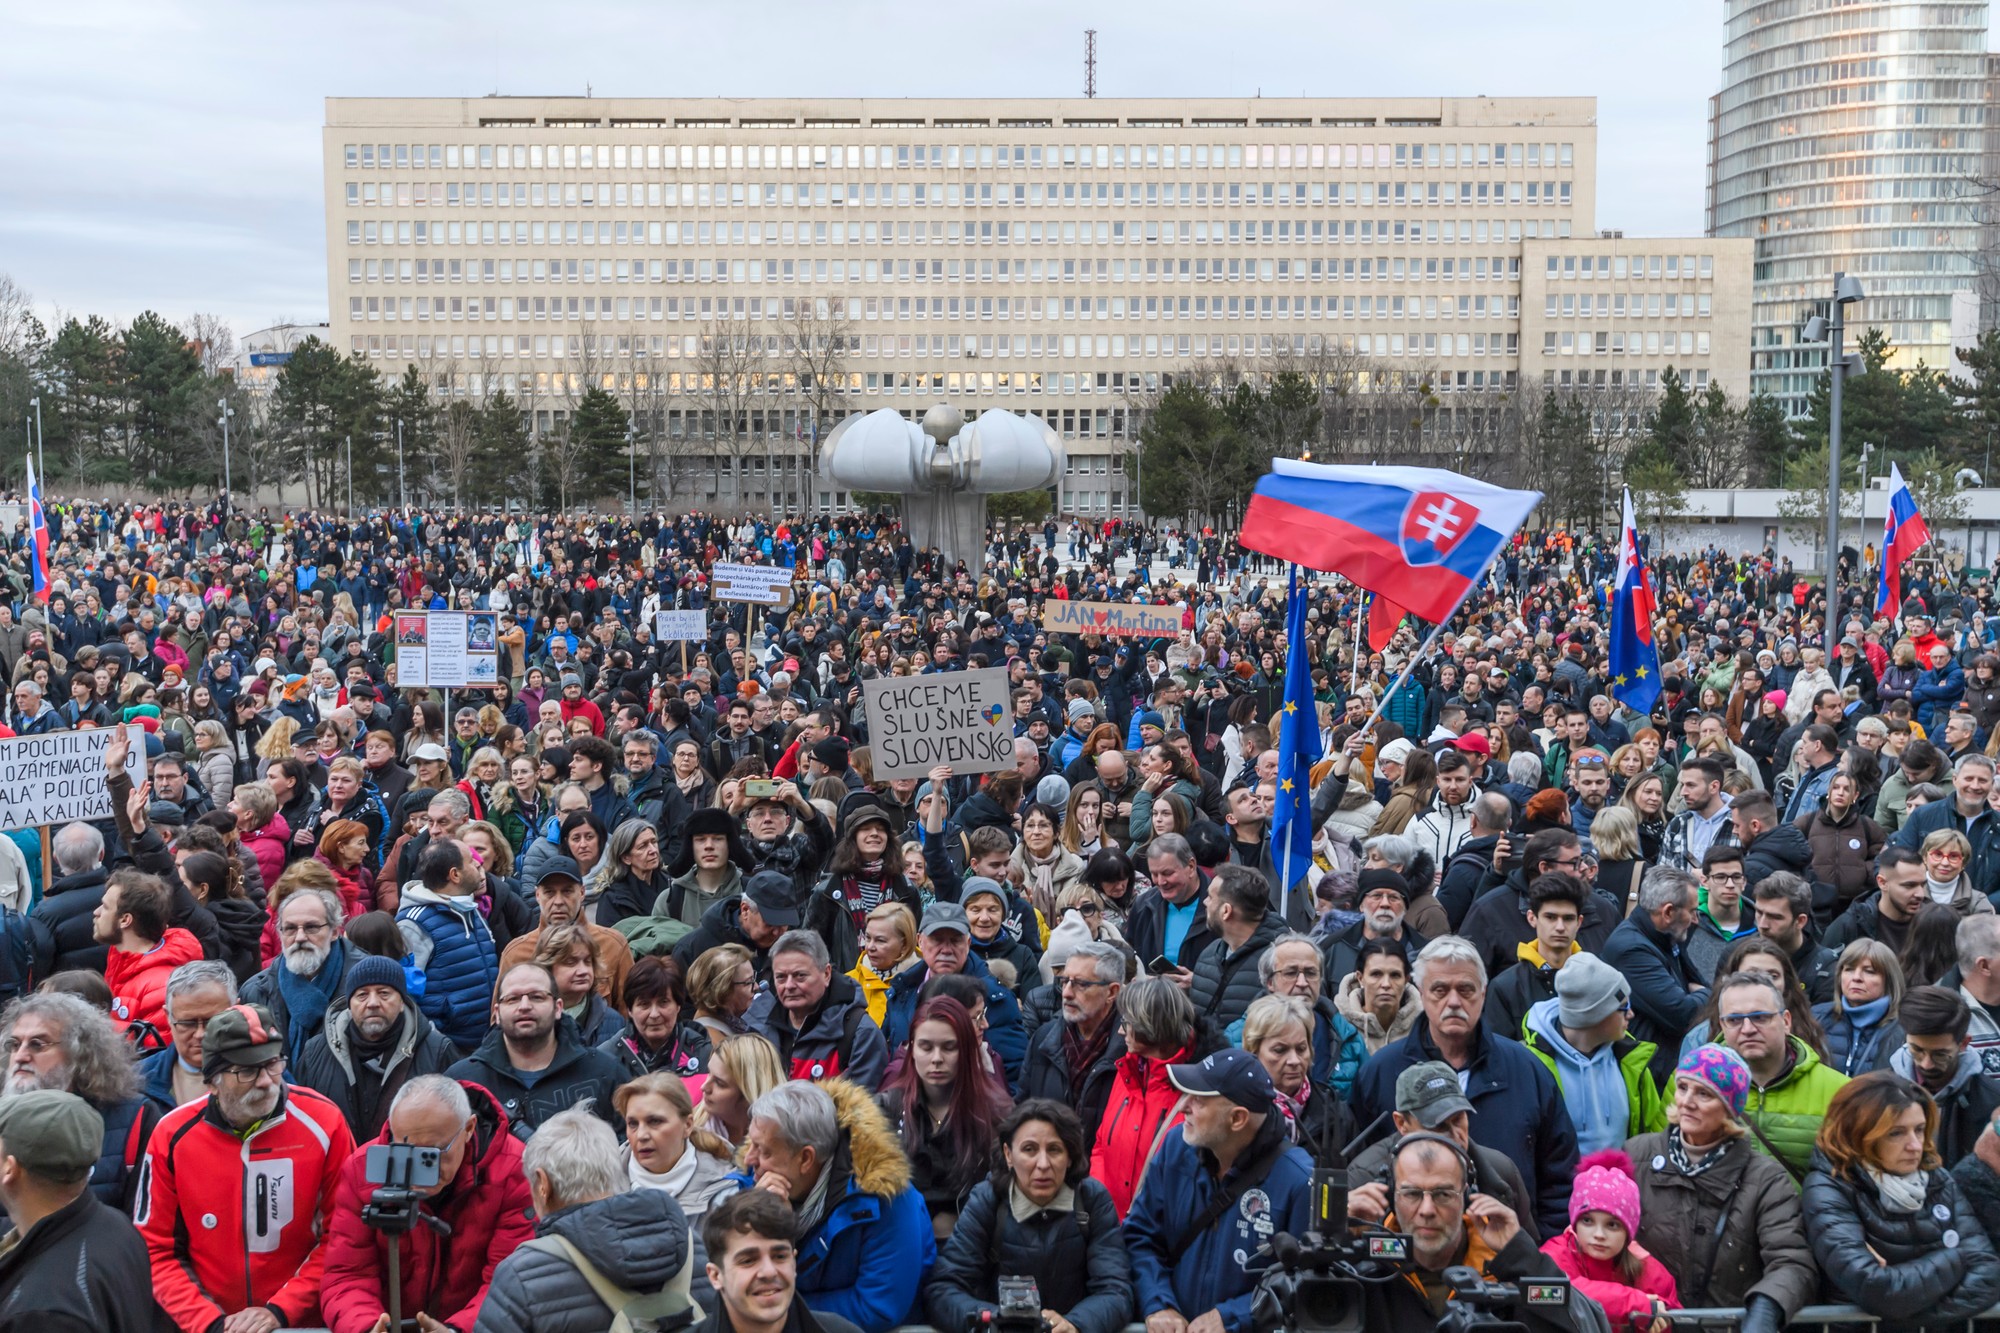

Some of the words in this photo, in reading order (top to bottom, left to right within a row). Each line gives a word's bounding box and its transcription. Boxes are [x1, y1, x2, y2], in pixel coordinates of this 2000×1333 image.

[658, 612, 677, 622] Práve
[680, 612, 687, 625] by
[1053, 602, 1095, 625] JÁN
[1107, 608, 1179, 632] Martina
[878, 682, 982, 712] CHCEME
[883, 704, 979, 736] SLUŠNÉ
[17, 736, 81, 759] POCÍTIL
[882, 731, 1012, 768] SLOVENSKO
[24, 808, 38, 825] A
[1531, 1288, 1562, 1298] FTJ
